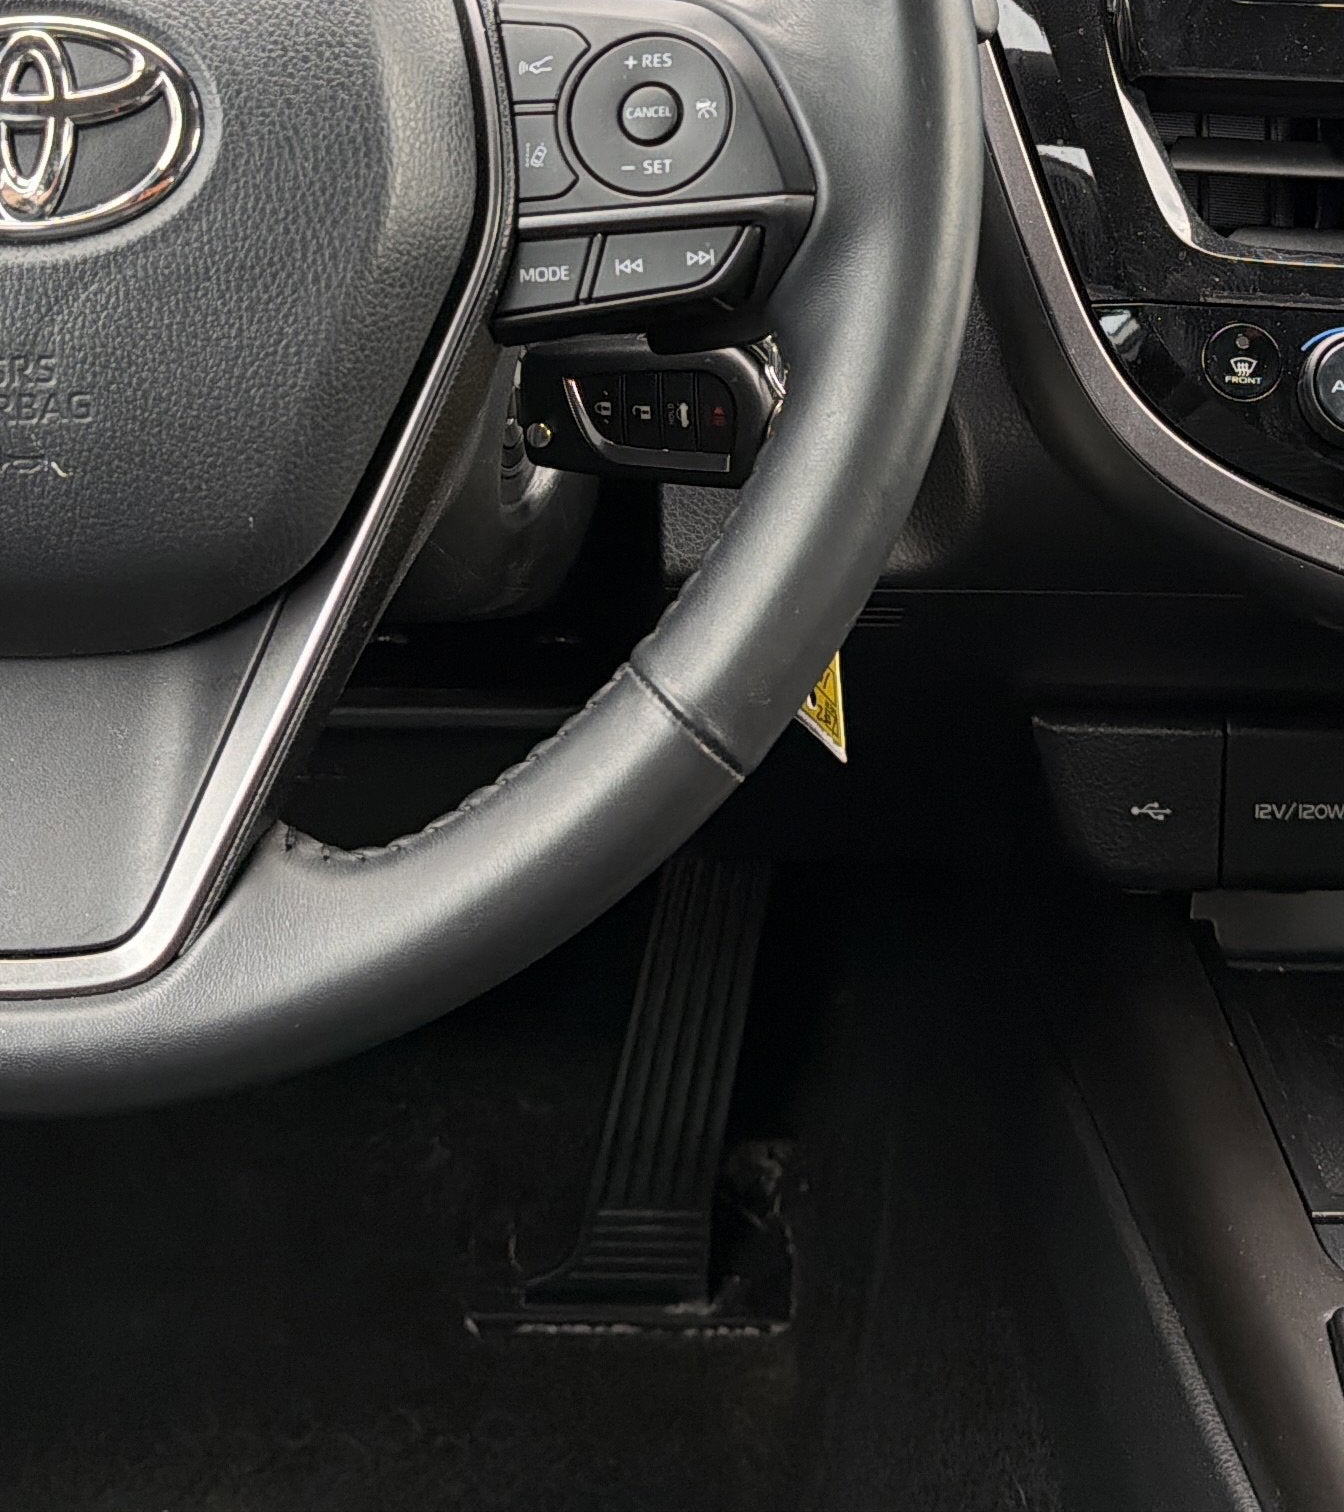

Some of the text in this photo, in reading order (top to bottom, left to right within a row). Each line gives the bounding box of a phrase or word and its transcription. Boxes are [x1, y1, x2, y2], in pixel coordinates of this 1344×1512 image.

[642, 53, 673, 69] RES
[626, 105, 672, 120] CANCEL
[643, 159, 673, 176] SET
[519, 265, 570, 284] MODE
[1225, 375, 1262, 385] FRONT
